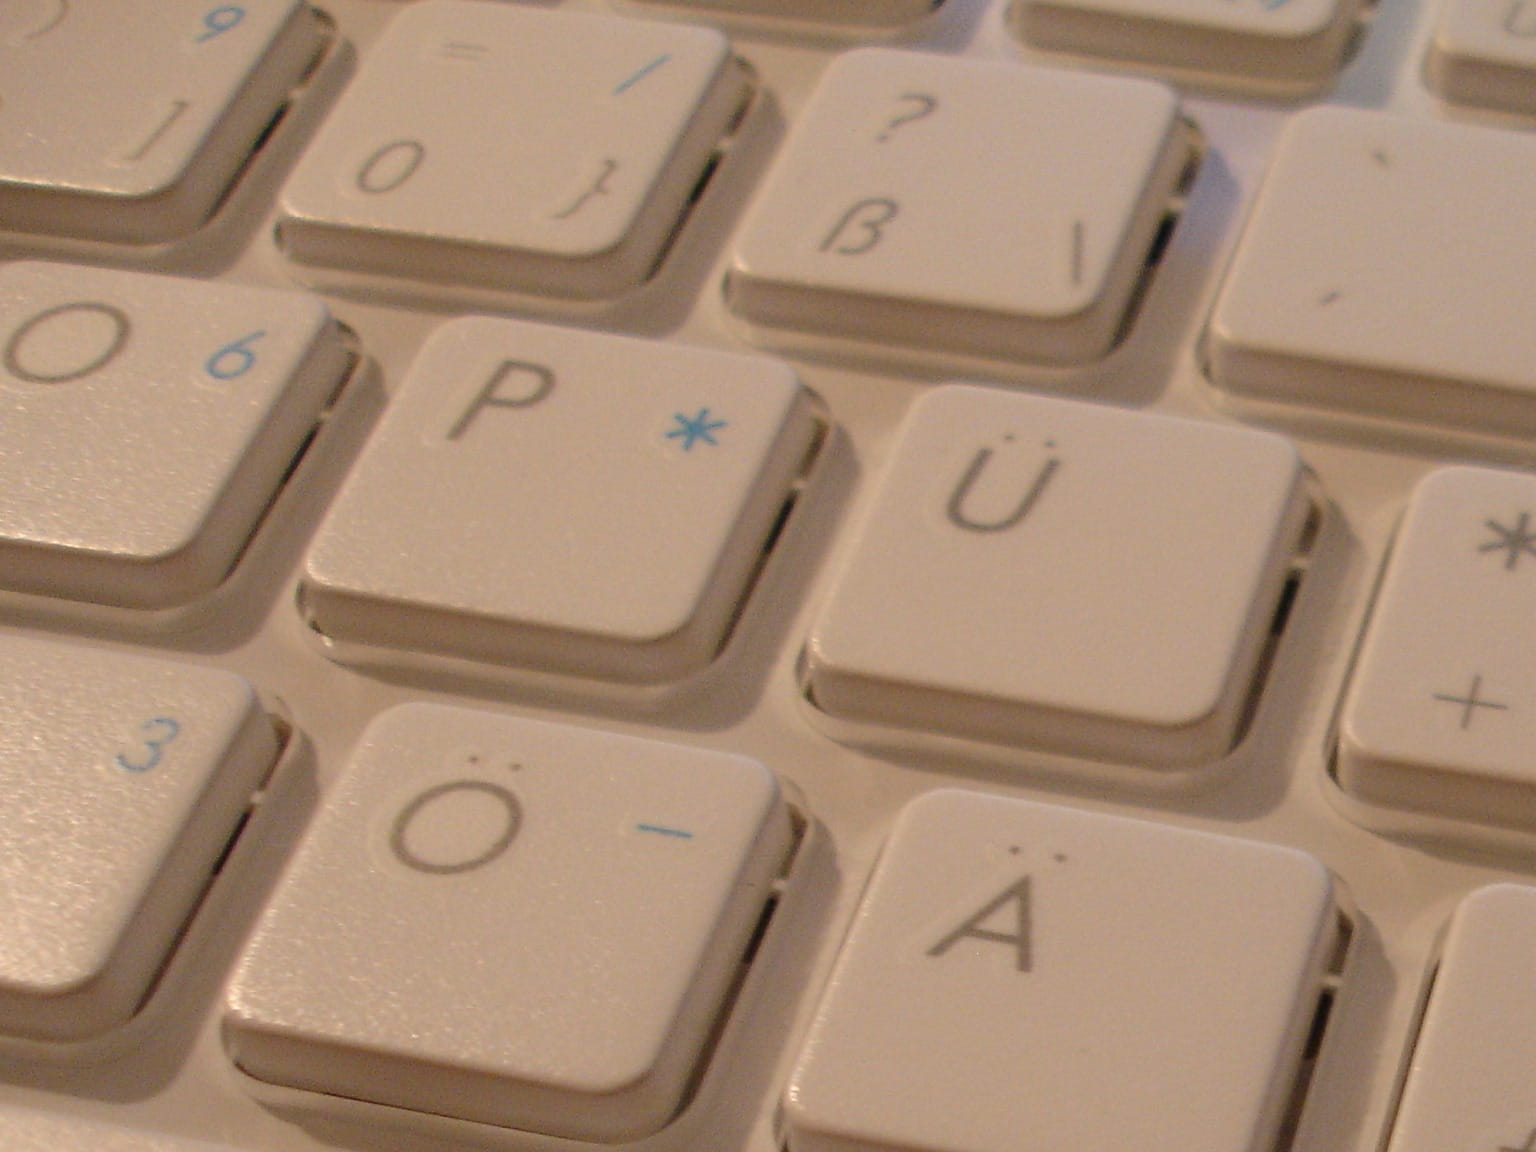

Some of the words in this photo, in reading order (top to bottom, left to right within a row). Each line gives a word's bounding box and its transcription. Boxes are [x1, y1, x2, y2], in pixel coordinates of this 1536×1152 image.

[196, 5, 244, 43] 9
[613, 54, 672, 96] /
[877, 94, 936, 141] ?
[204, 331, 266, 380] 6
[447, 360, 555, 440] P
[946, 434, 1061, 533] Ü
[1432, 675, 1508, 730] +
[115, 717, 181, 773] 3
[390, 755, 523, 875] Ö
[925, 845, 1068, 973] Ä
